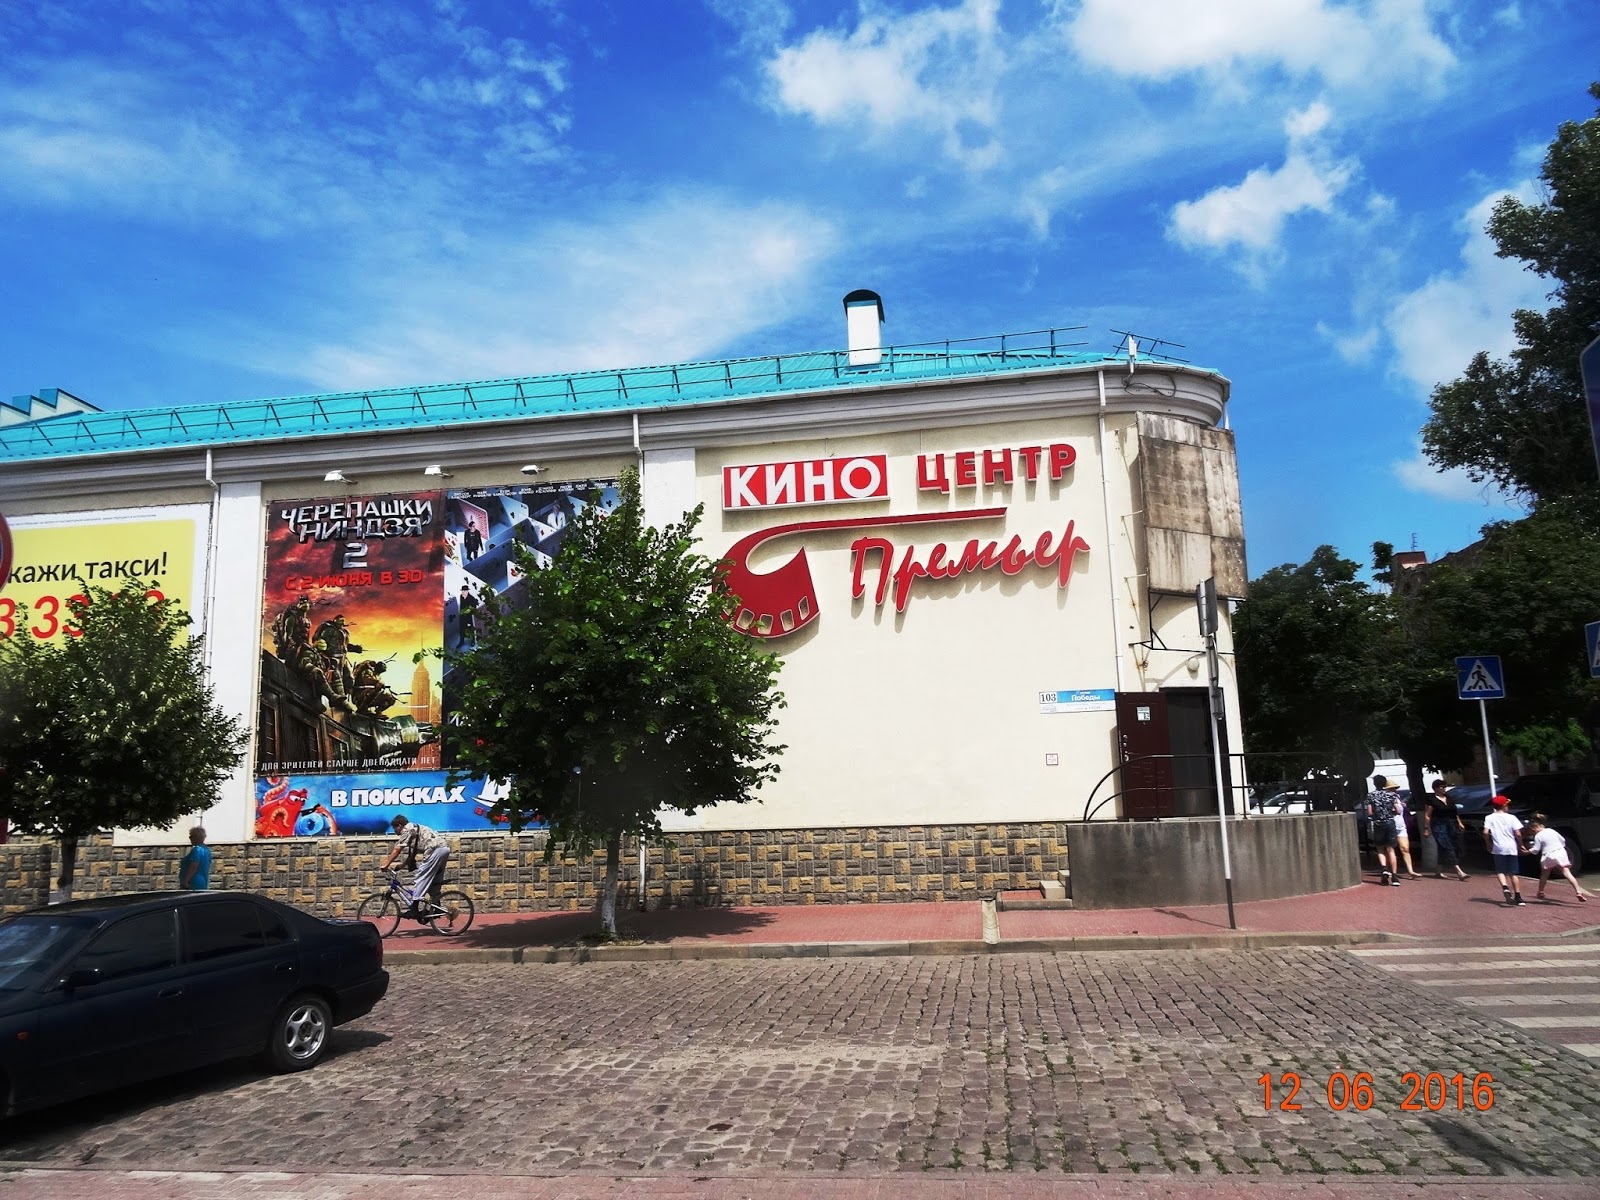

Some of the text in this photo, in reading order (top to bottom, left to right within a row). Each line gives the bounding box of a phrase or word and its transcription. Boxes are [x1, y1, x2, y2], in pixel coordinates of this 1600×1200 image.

[729, 443, 1078, 507] КИНО ЦЕНТР
[281, 499, 433, 535] ЧЕРЕПАШКИ
[299, 516, 424, 543] НИНДЗЯ
[84, 551, 167, 580] такси!
[342, 541, 369, 569] 2
[850, 519, 1091, 612] Премьер
[285, 569, 423, 590] С 2 ИЮНЯ В 3D
[1041, 693, 1057, 702] 103
[1071, 694, 1101, 702] Победы
[260, 756, 436, 771] ДЛЯ ЗРИТЕЛЕЙ СТАРШЕ ДВЕНАДЦАТИ ЛЕТ
[331, 790, 348, 807] В
[351, 785, 466, 806] ПОИСКАХ
